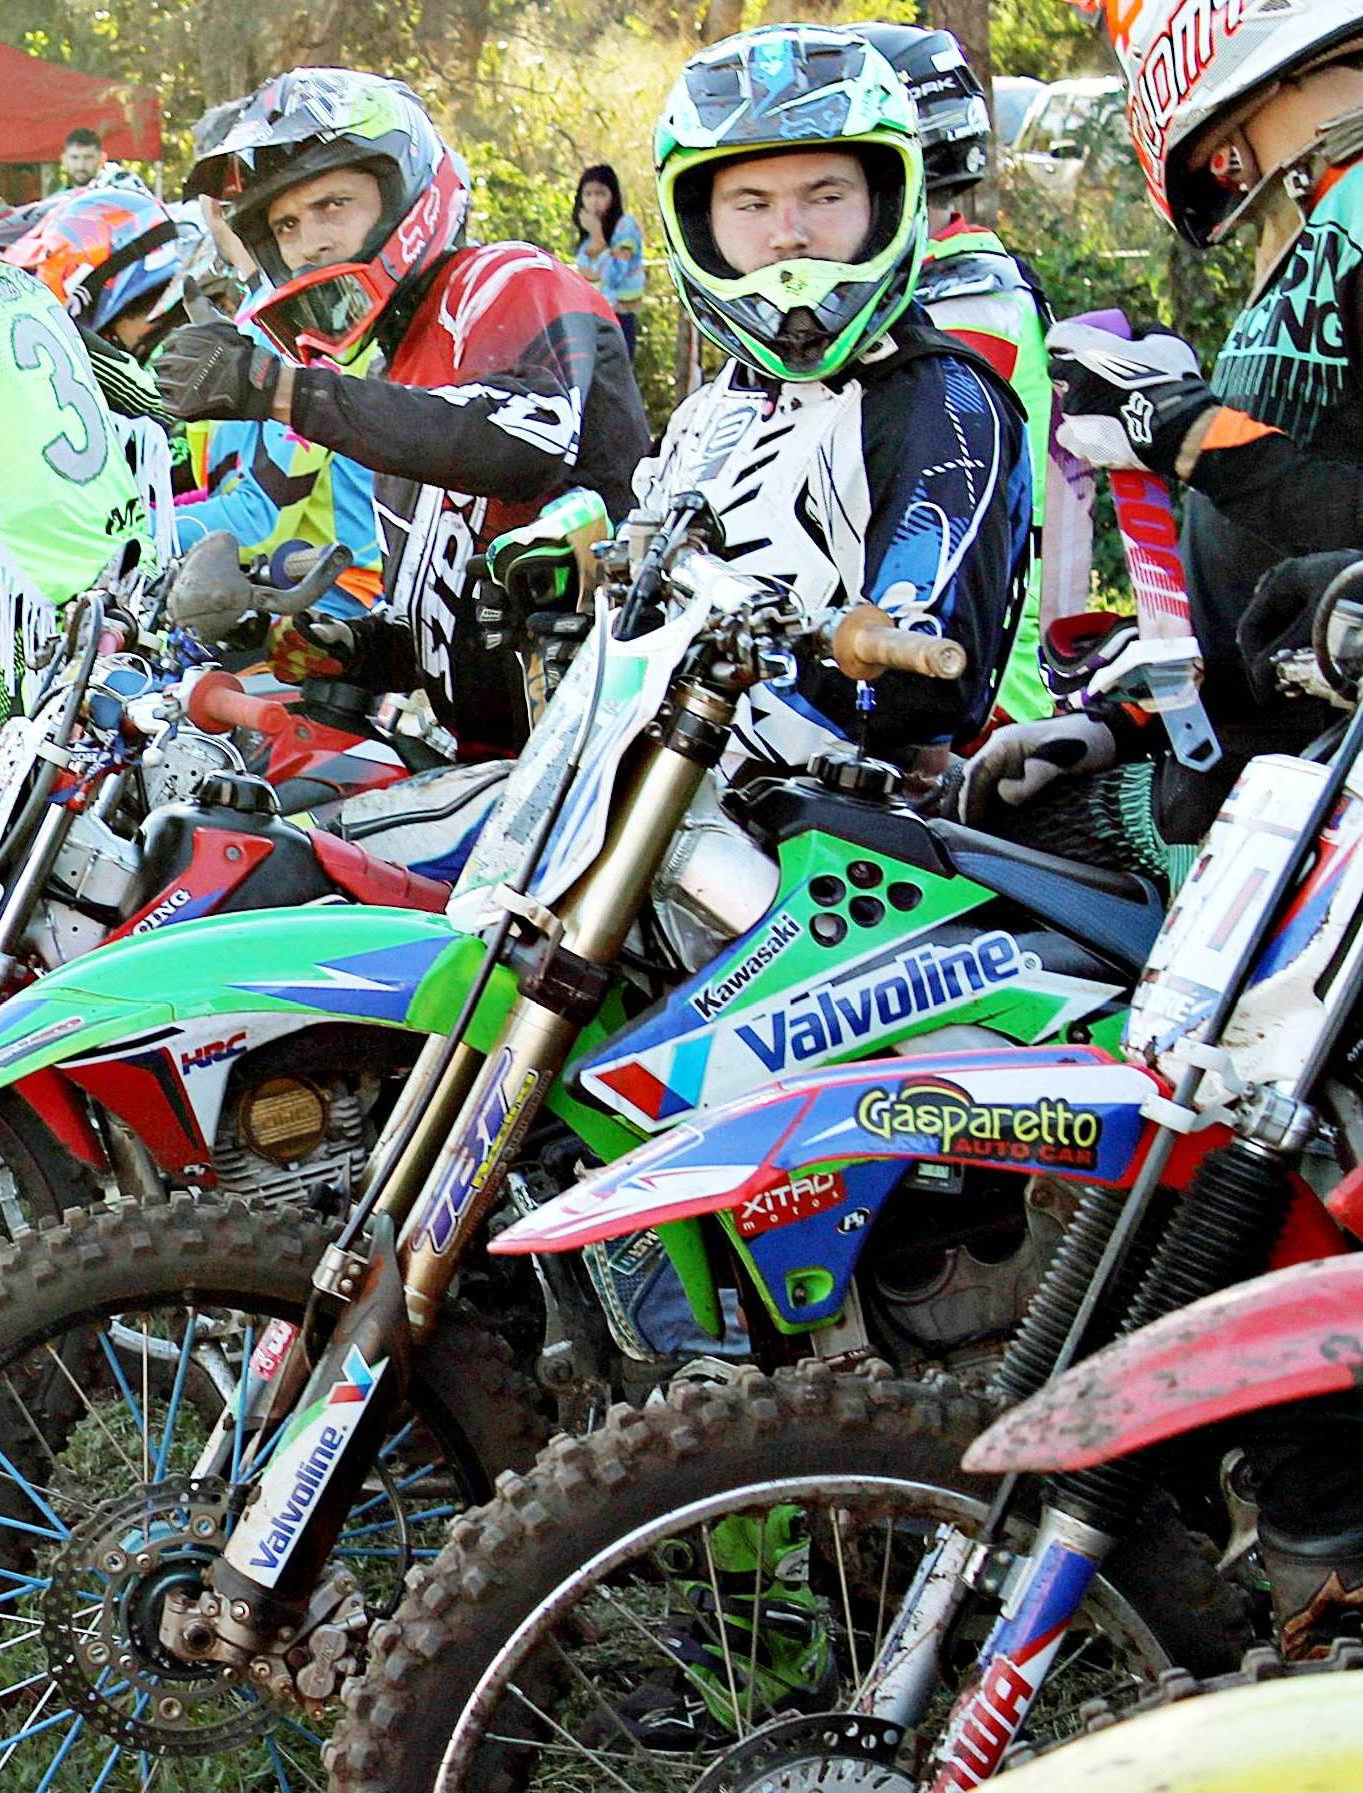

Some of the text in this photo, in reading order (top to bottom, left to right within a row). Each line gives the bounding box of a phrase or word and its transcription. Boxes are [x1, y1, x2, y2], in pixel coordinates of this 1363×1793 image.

[694, 914, 801, 1018] Kawasaki
[734, 935, 1020, 1073] Valvoline
[181, 1032, 247, 1075] HRC
[857, 1088, 1098, 1153] Gasparetto
[953, 1137, 1096, 1165] AUTO CAR
[249, 1425, 345, 1569] Valvoline
